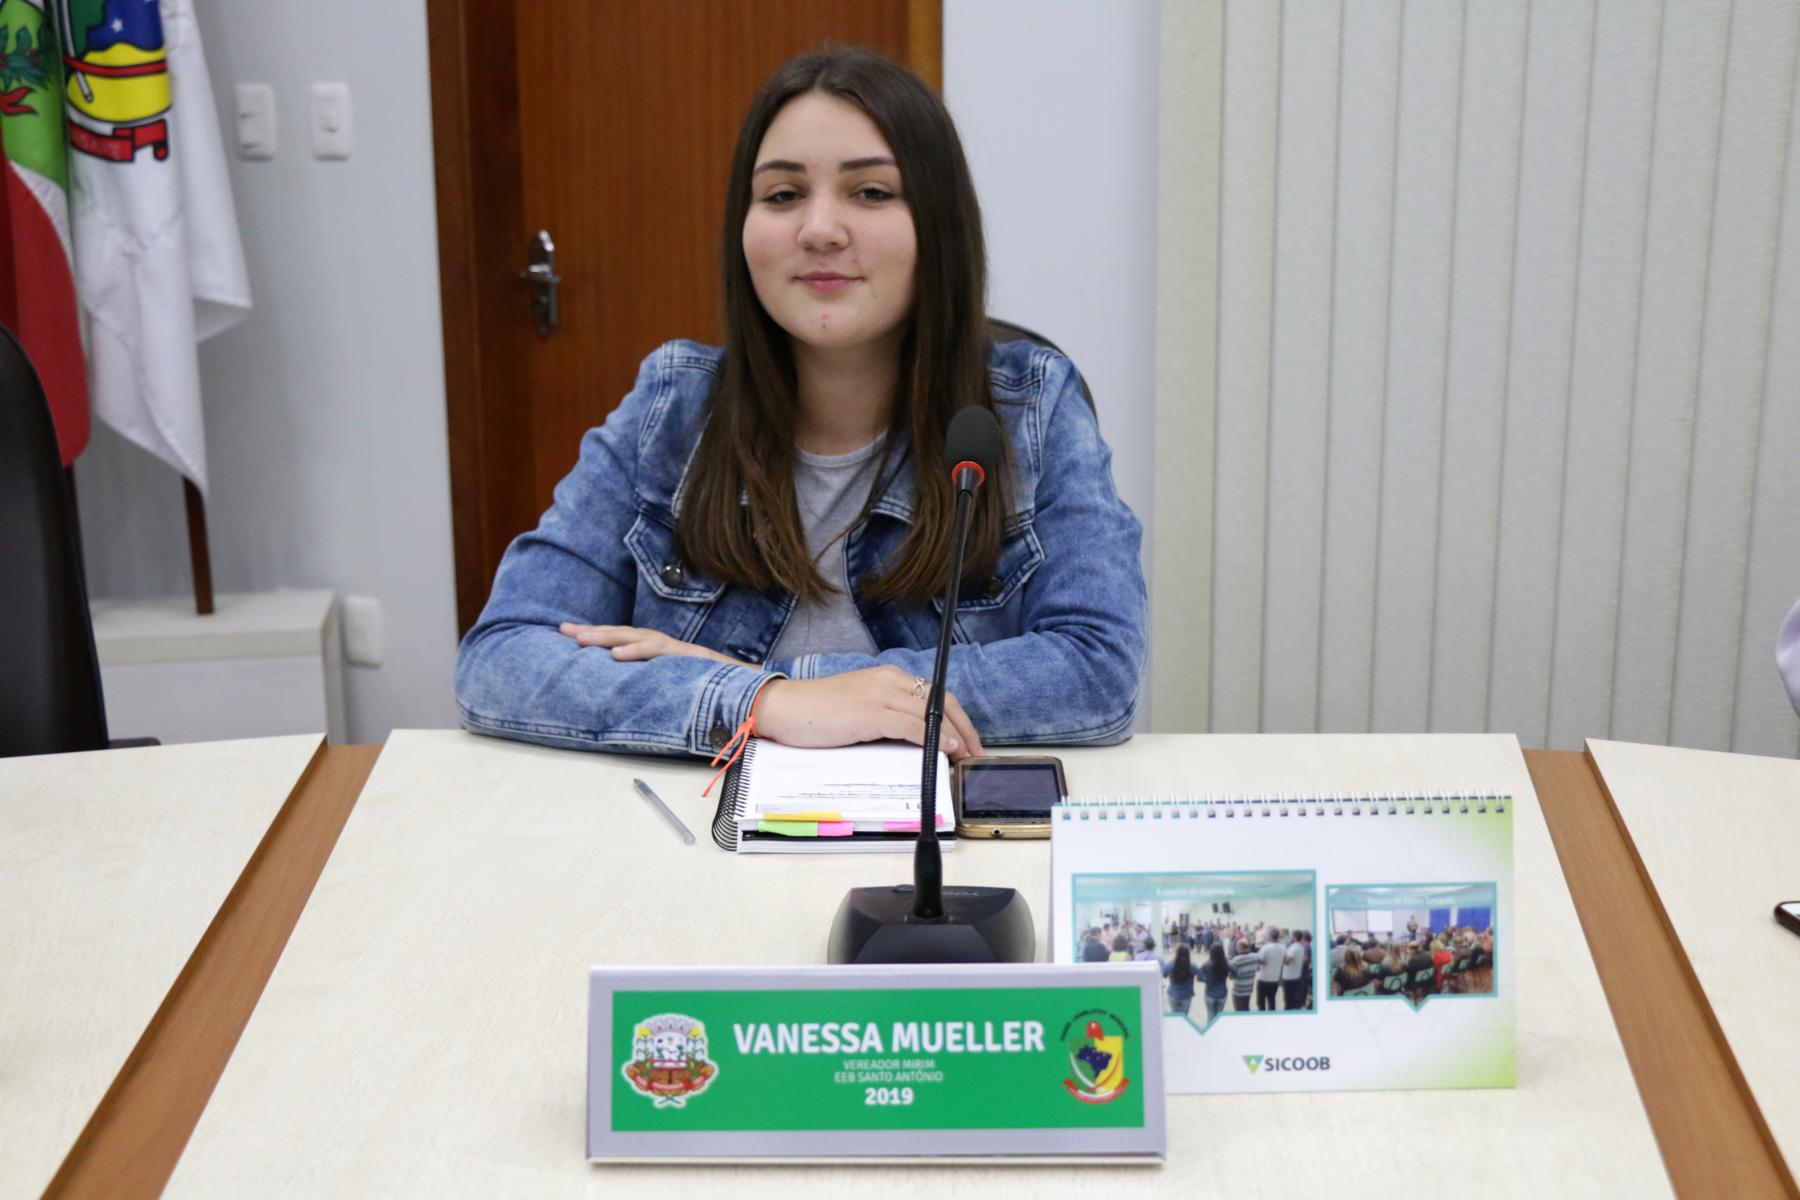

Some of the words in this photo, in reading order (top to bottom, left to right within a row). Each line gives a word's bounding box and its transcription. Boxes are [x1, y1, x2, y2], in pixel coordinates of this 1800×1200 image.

[733, 1022, 884, 1053] VANESSA
[891, 1020, 1045, 1052] MUELLER
[843, 1059, 900, 1070] VEREADOR
[902, 1059, 935, 1070] MIRIM
[1264, 1056, 1331, 1072] SICOOB
[834, 1071, 856, 1082] EEB
[857, 1071, 893, 1082] SANTO
[895, 1069, 944, 1082] ANTÔNIO
[864, 1087, 914, 1105] 2019
